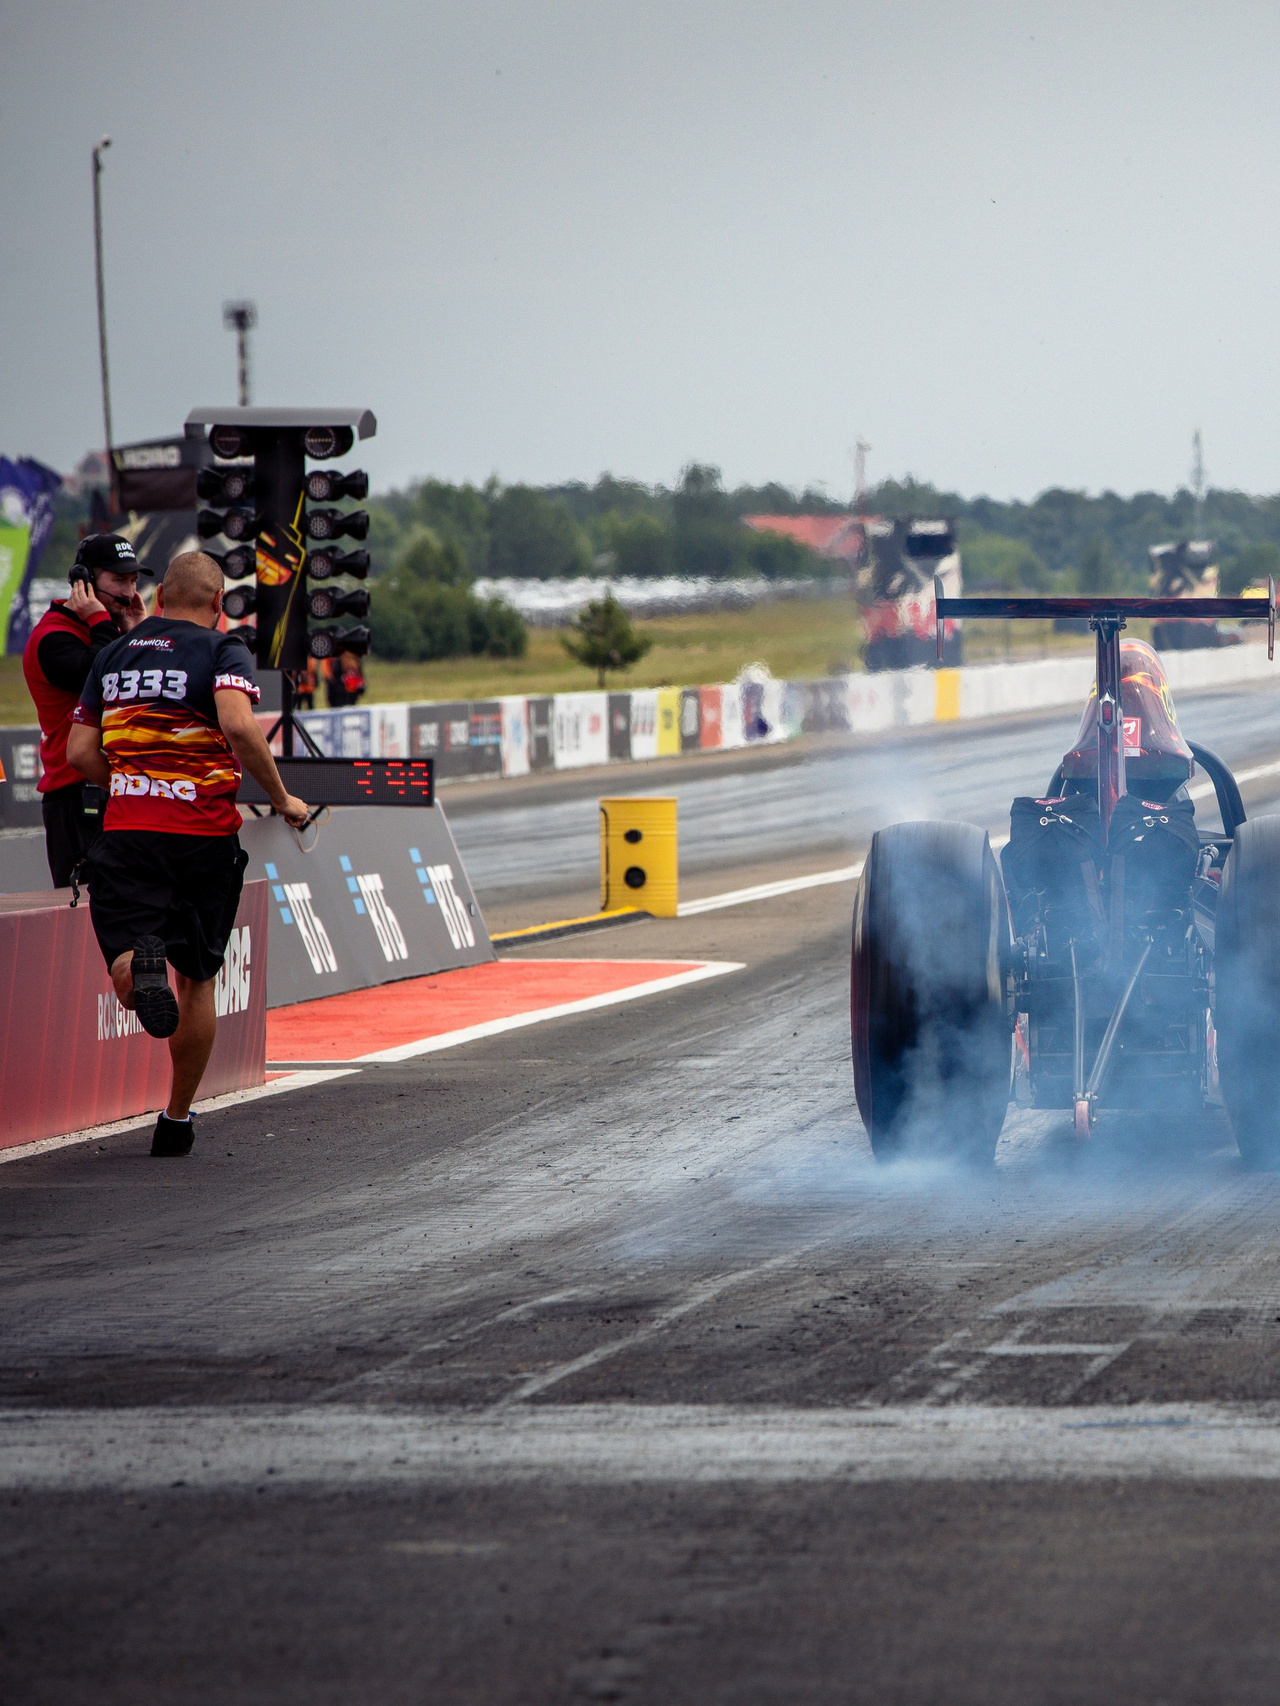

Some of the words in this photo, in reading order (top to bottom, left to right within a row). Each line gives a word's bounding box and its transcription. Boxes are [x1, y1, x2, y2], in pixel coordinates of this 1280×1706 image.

[101, 669, 188, 702] 8333
[110, 773, 197, 802] RDRC
[213, 925, 251, 1018] DRC
